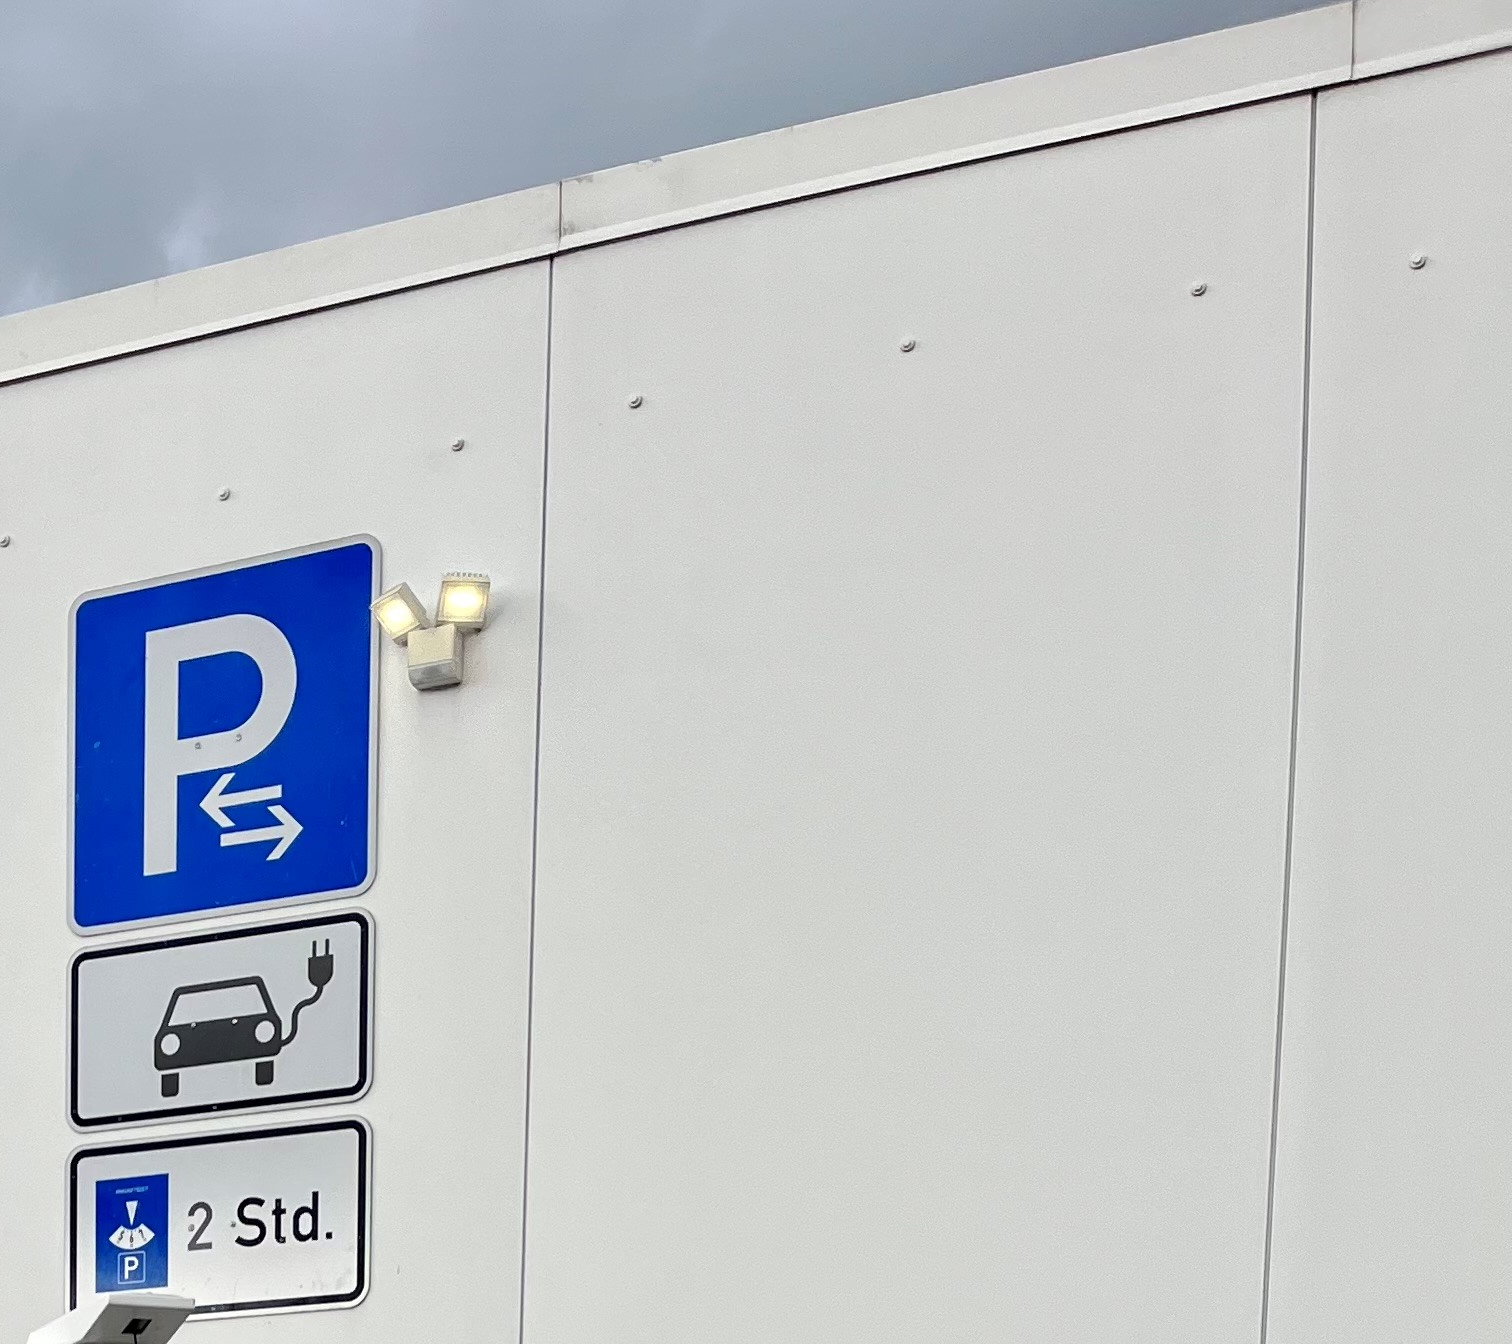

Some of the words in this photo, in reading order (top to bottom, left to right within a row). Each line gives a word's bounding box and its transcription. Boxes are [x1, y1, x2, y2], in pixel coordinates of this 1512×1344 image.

[143, 613, 298, 876] P
[187, 1202, 213, 1251] 2
[235, 1191, 333, 1247] Std.
[124, 1256, 139, 1280] P
